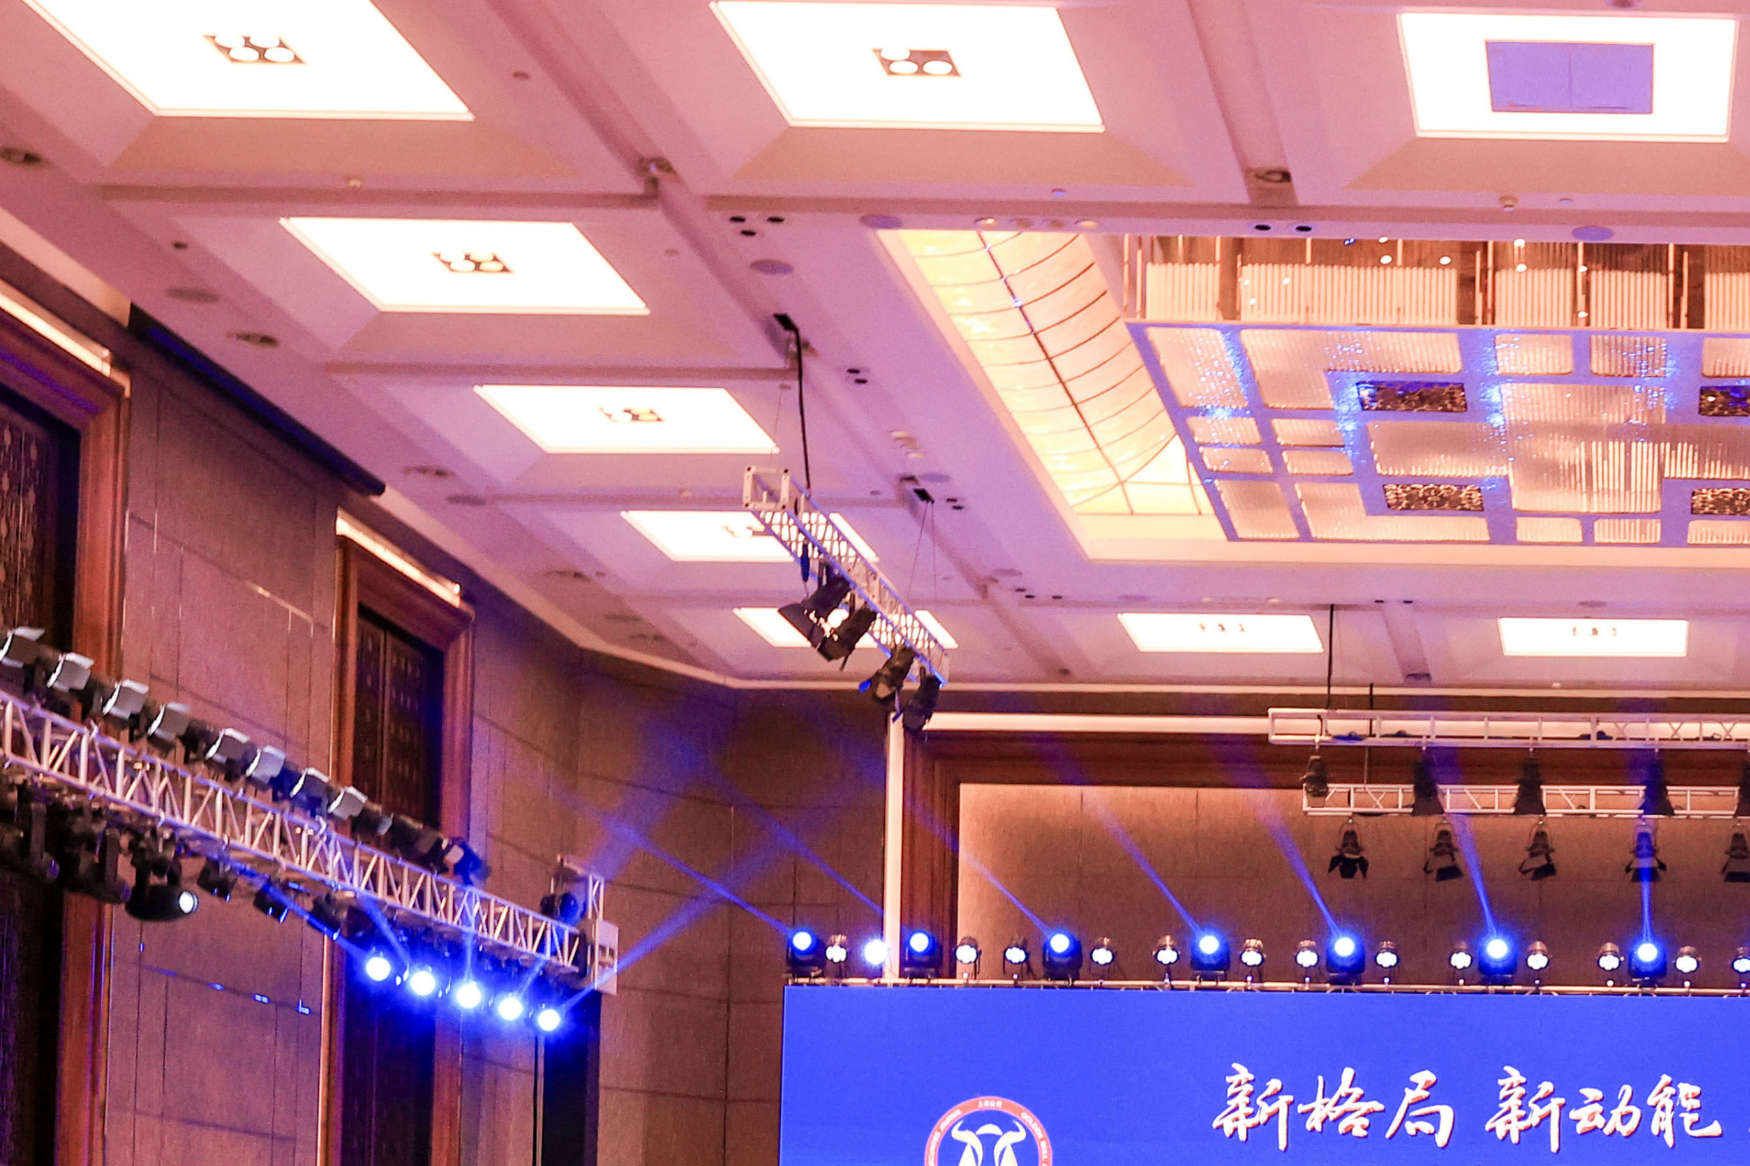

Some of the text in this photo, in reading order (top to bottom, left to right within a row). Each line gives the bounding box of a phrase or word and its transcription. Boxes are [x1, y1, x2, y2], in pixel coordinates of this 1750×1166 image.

[1212, 1062, 1455, 1151] 新格局
[1484, 1066, 1723, 1153] 新动能
